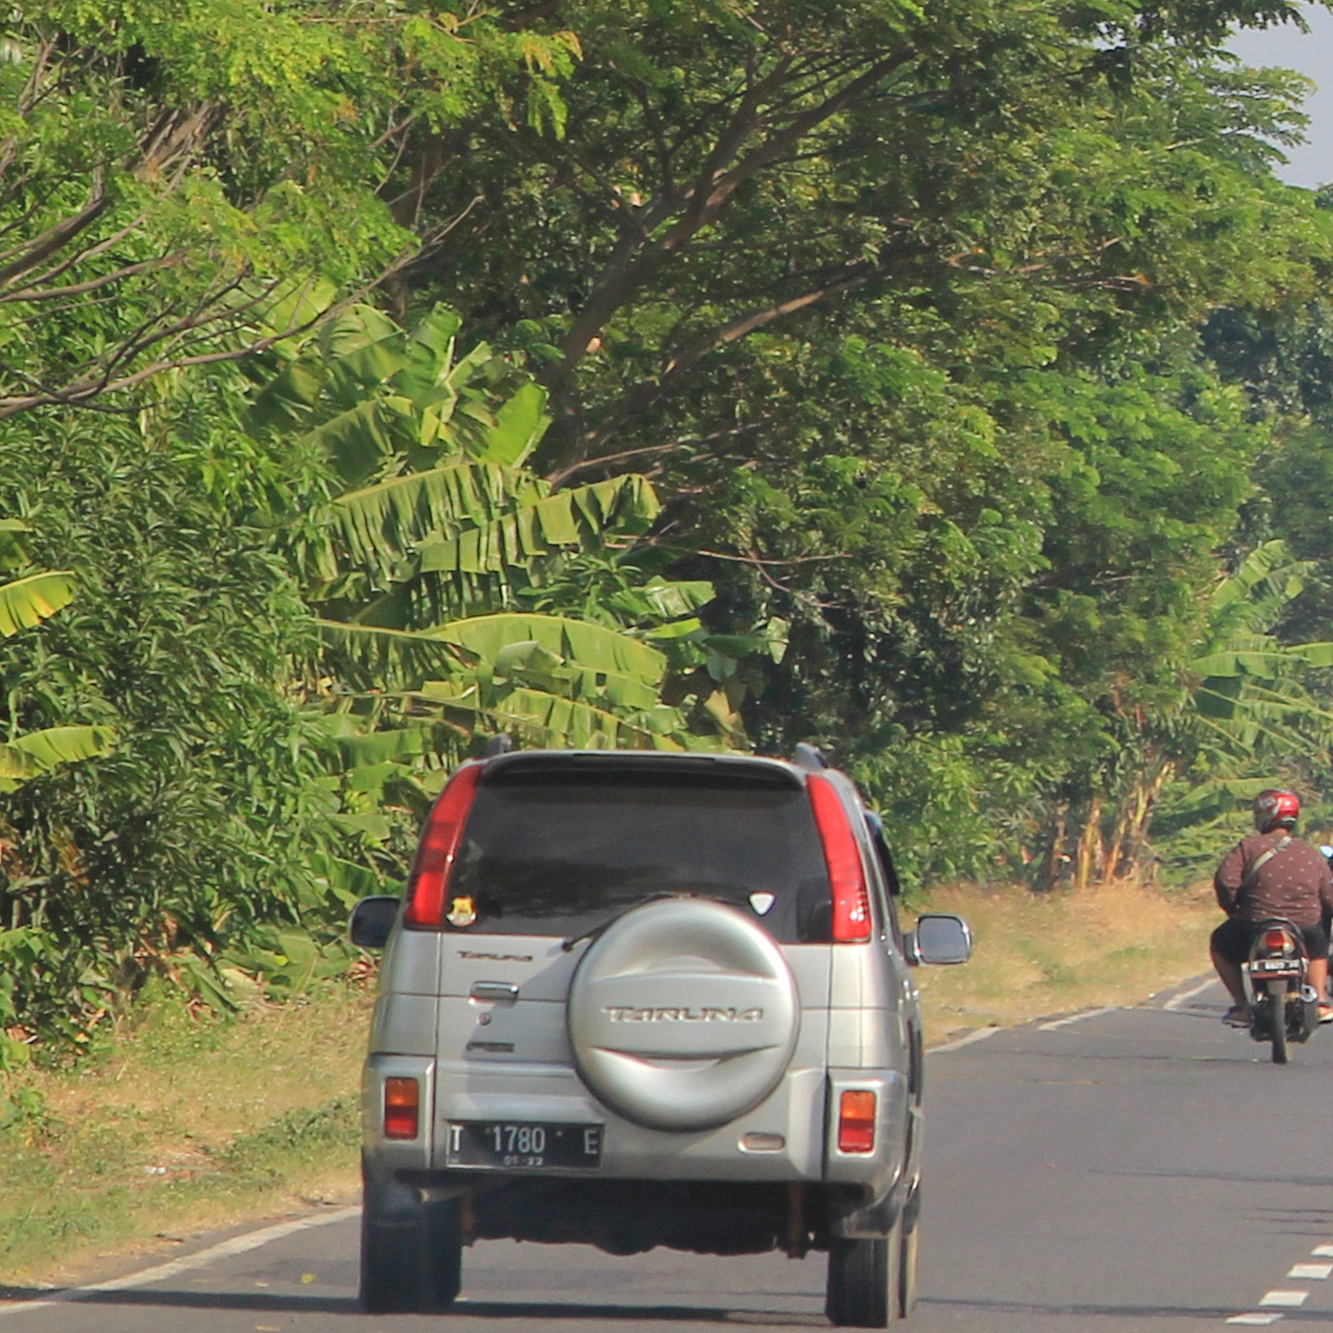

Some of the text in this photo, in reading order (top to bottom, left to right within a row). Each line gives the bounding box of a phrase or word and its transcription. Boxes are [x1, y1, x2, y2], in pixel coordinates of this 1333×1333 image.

[601, 1005, 764, 1023] TARUNA
[451, 1124, 598, 1155] T 1780 E
